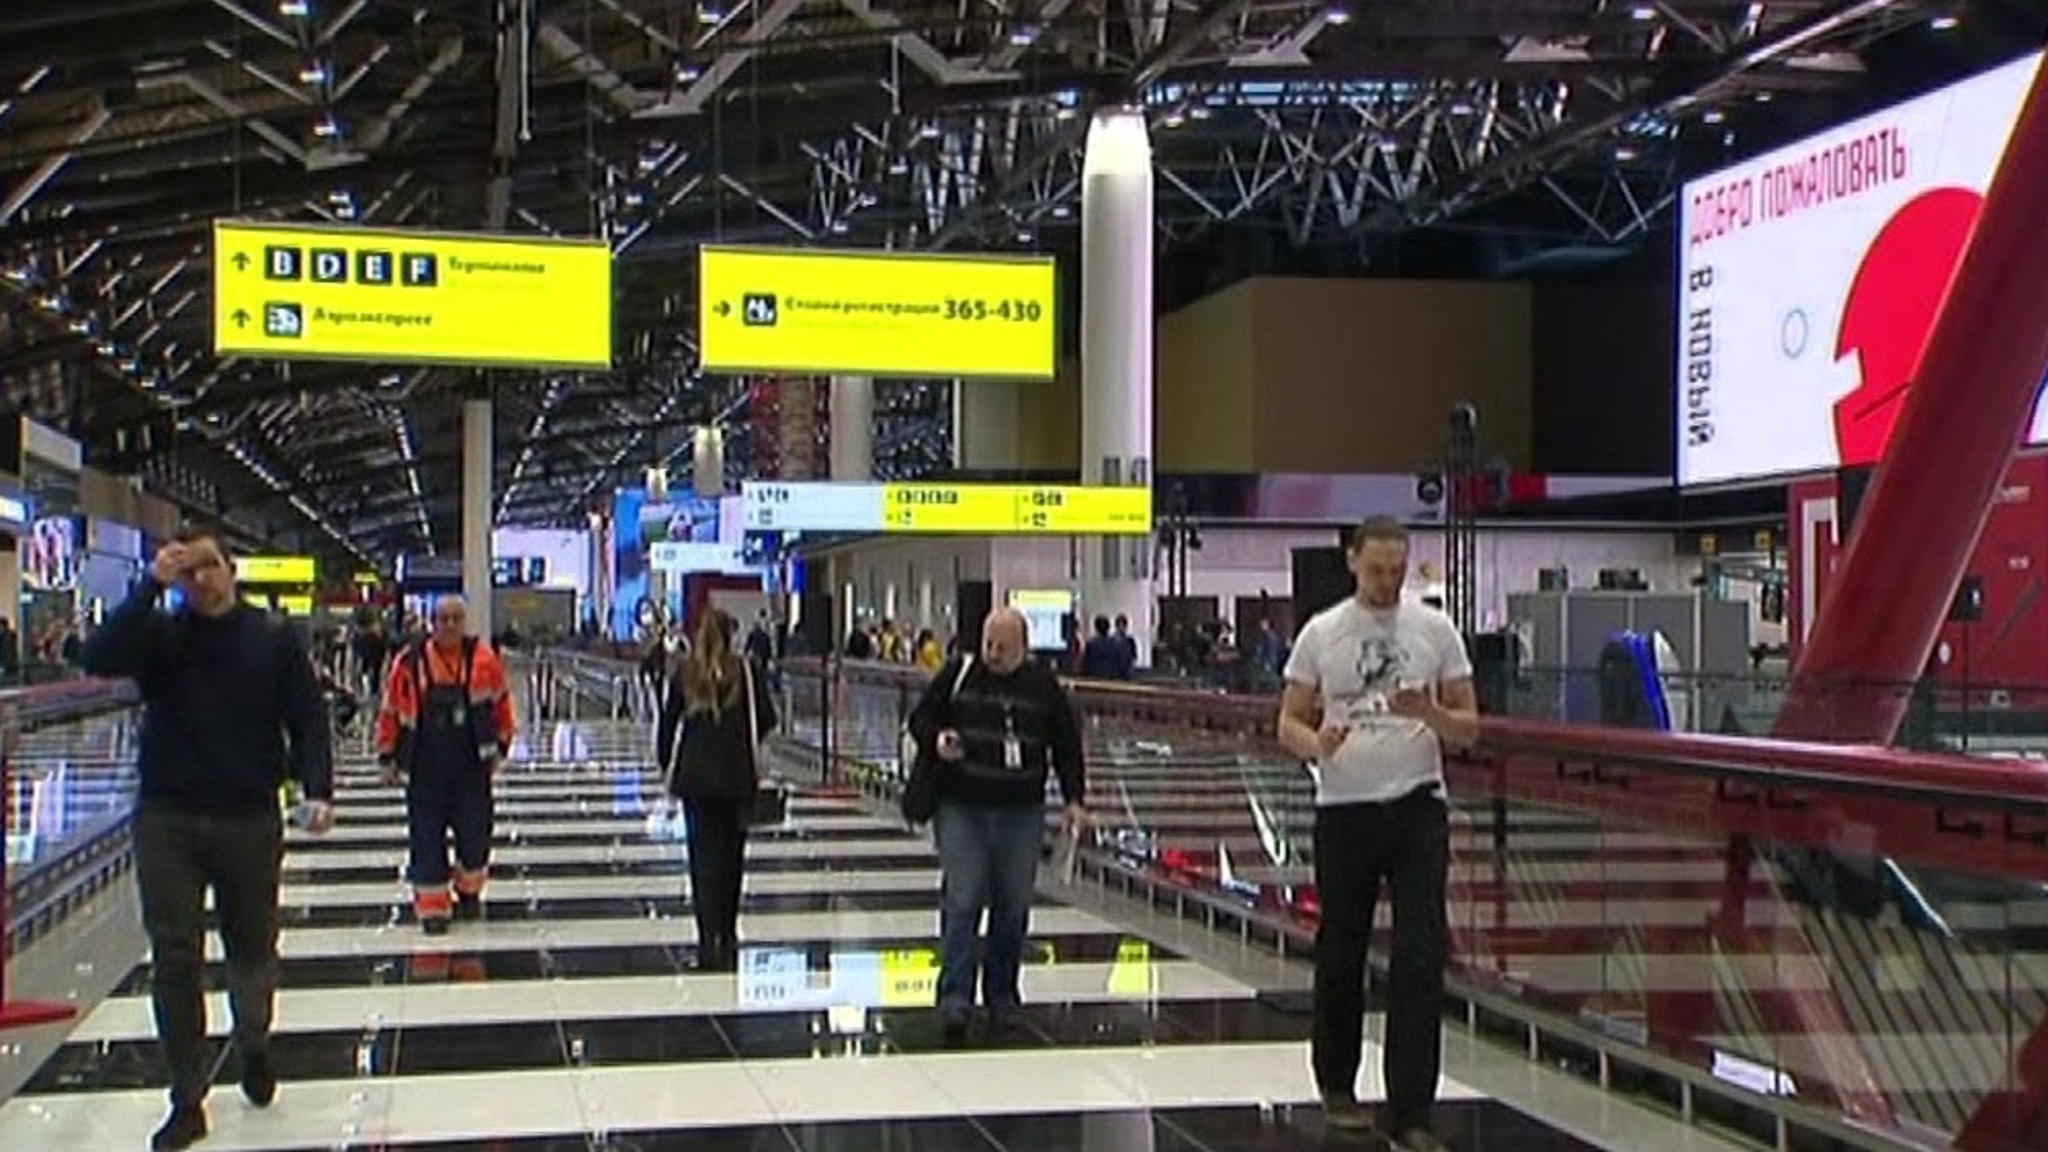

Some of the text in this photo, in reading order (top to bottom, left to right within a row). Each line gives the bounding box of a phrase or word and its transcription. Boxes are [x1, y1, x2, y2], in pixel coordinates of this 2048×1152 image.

[1690, 127, 1906, 247] ДОБРО ПОЖАЛОВАТЬ
[273, 250, 294, 276] B
[317, 253, 341, 279] D
[365, 256, 384, 280] E
[410, 257, 428, 283] F
[943, 298, 1042, 323] 365-430
